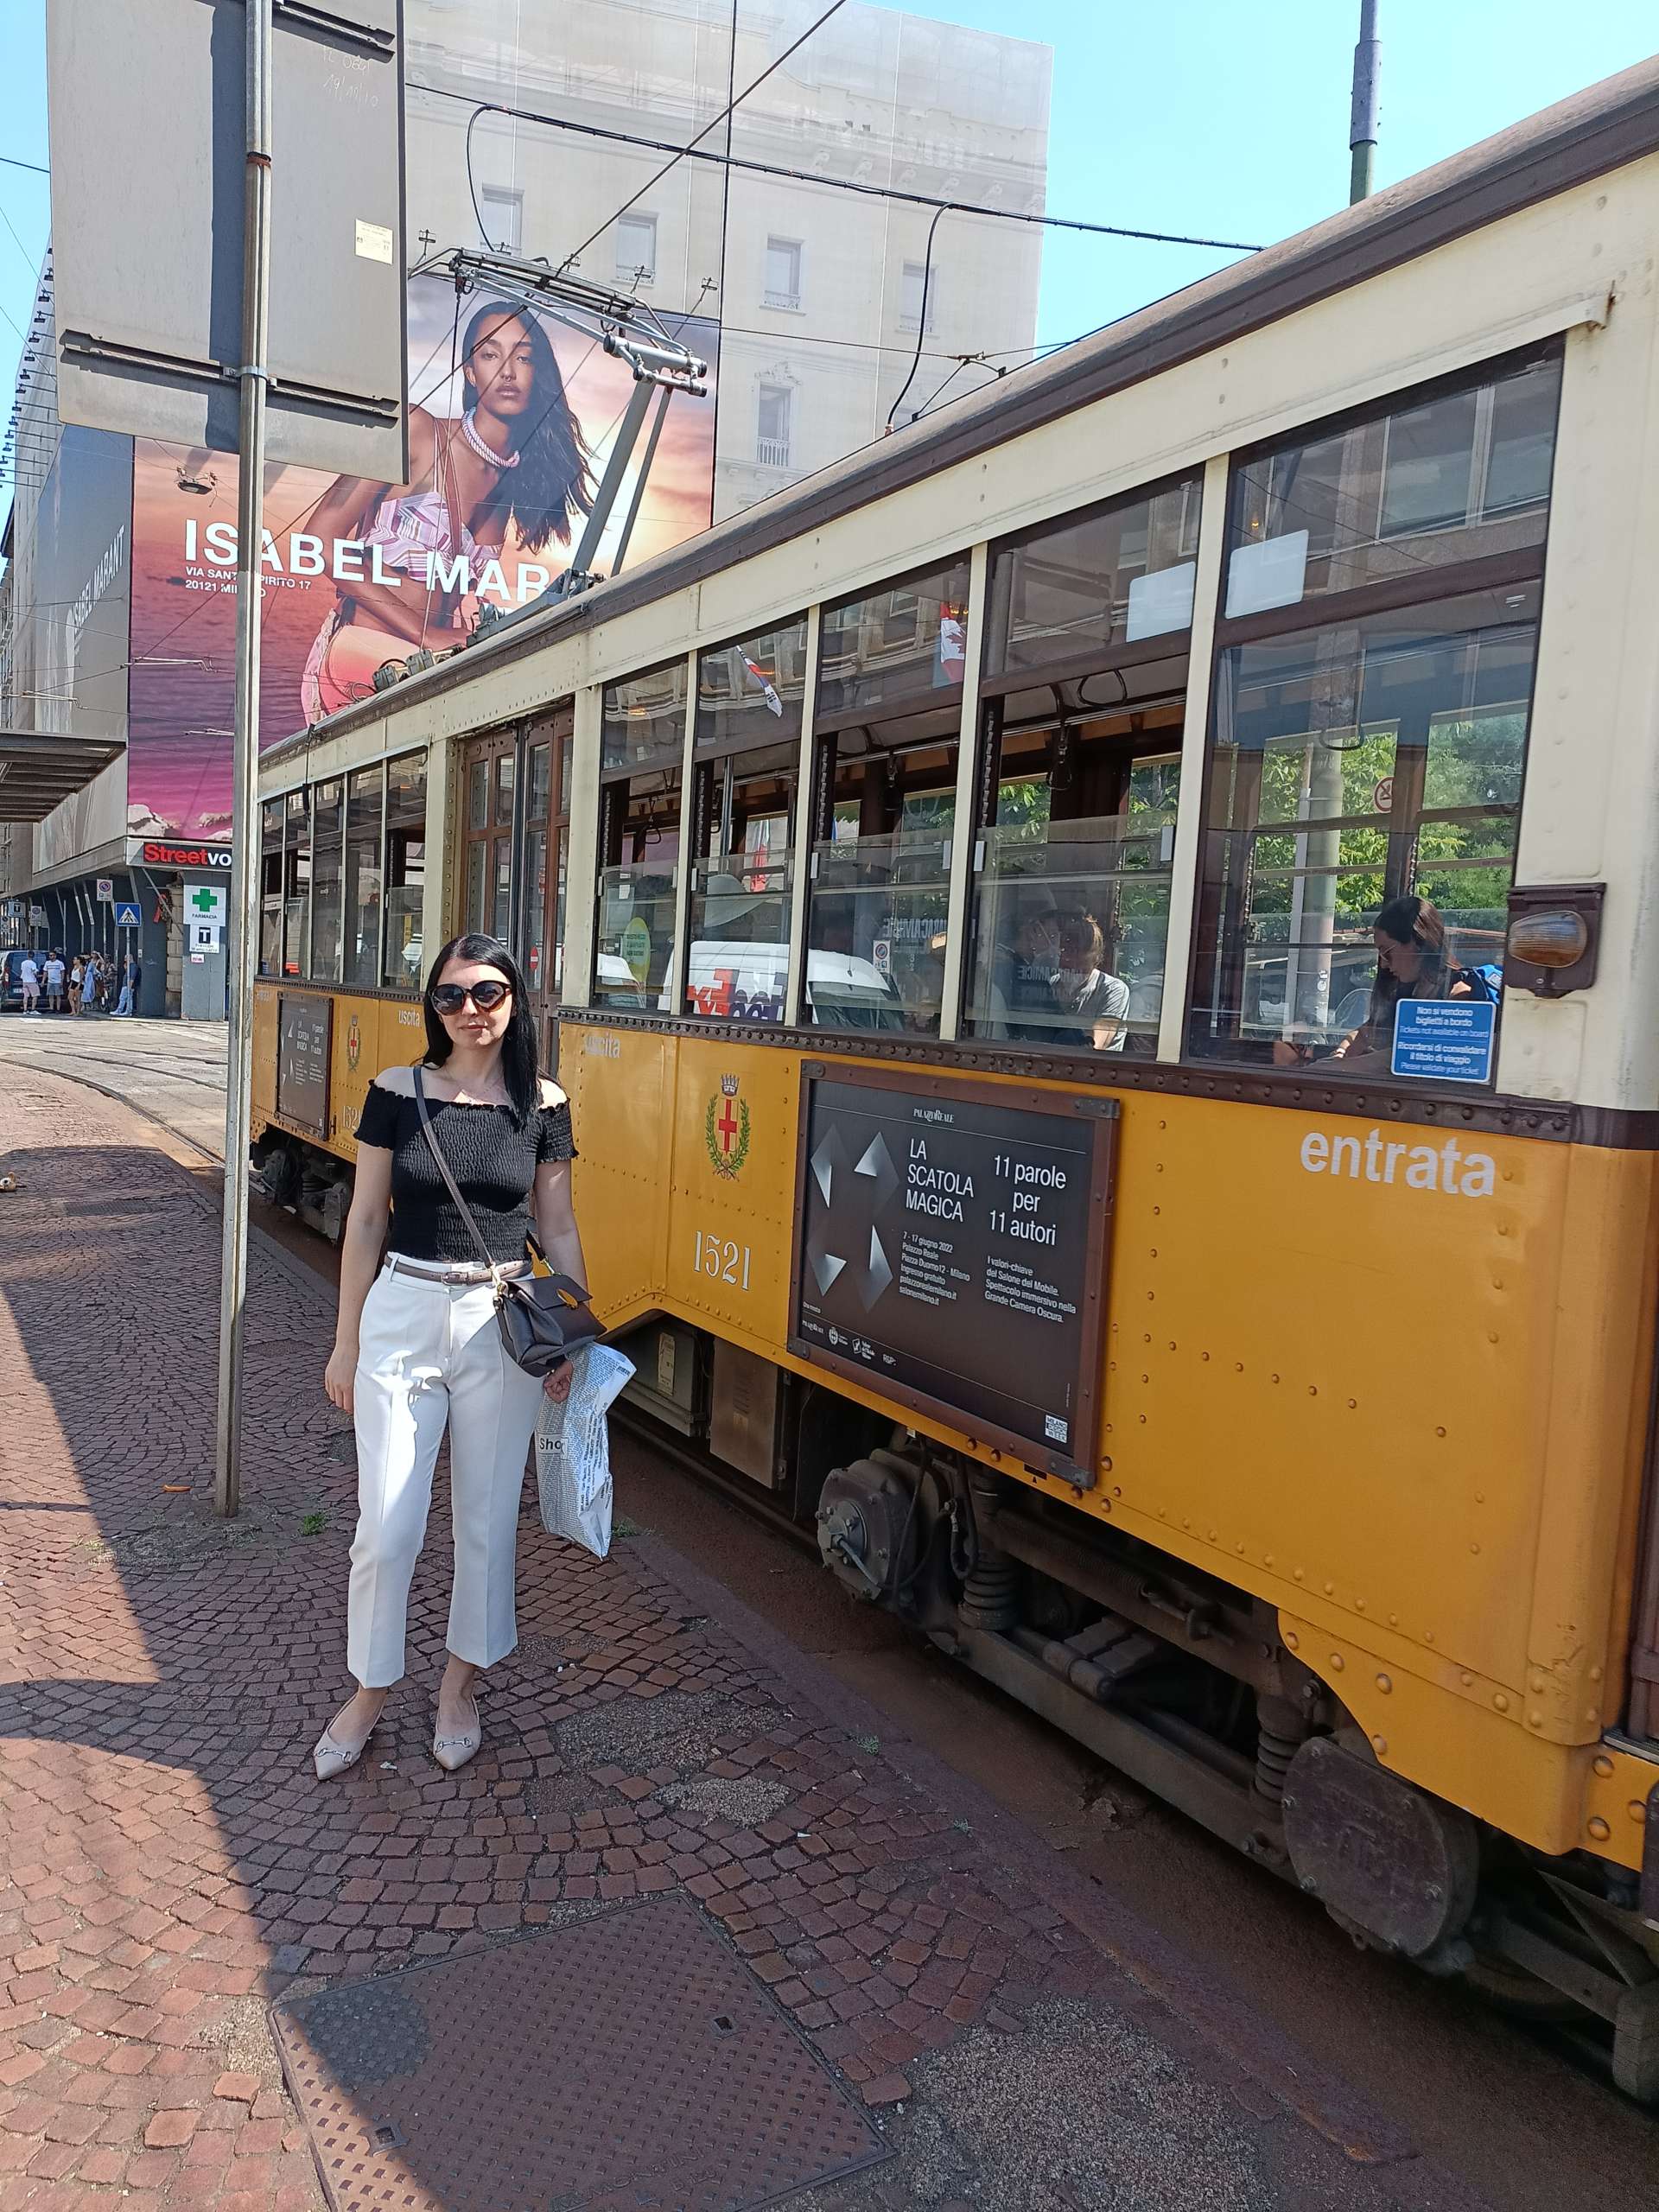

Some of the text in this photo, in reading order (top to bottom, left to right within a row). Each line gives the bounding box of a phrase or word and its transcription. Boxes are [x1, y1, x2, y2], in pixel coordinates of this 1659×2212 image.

[93, 524, 124, 607] MARANT
[185, 518, 550, 602] ISABEL MAR
[185, 580, 217, 592] 20121
[186, 567, 311, 589] VIA SANT PIRITO 17
[144, 842, 232, 867] Streetvo
[200, 929, 210, 942] T
[398, 1008, 421, 1027] uscita
[1416, 1016, 1443, 1026] biglietti
[1450, 1018, 1472, 1027] bordo
[1444, 1055, 1471, 1065] viaggio
[342, 1105, 361, 1130] 152
[910, 1138, 926, 1160] LA
[995, 1155, 1066, 1189] 11 parole
[1300, 1128, 1496, 1198] entrata
[907, 1164, 974, 1198] SCATOLA
[906, 1189, 963, 1222] MAGICA
[1013, 1192, 1040, 1212] per
[989, 1210, 1056, 1246] 11 autori
[902, 1242, 939, 1260] Palazzo Reale
[912, 1234, 918, 1243] 17
[918, 1236, 938, 1249] giugno
[938, 1242, 953, 1253] 2022
[694, 1230, 750, 1291] 1521
[902, 1253, 918, 1265] Piazza
[950, 1268, 970, 1281] Milano
[991, 1258, 1033, 1276] valori-chiave
[900, 1263, 945, 1285] Ingresso gratuito
[986, 1268, 997, 1278] del
[998, 1270, 1020, 1285] Salone
[1021, 1278, 1033, 1287] del
[985, 1290, 1008, 1305] Grande
[1009, 1298, 1036, 1313] Camera
[986, 1279, 1076, 1313] Spettacolo immersivo nella
